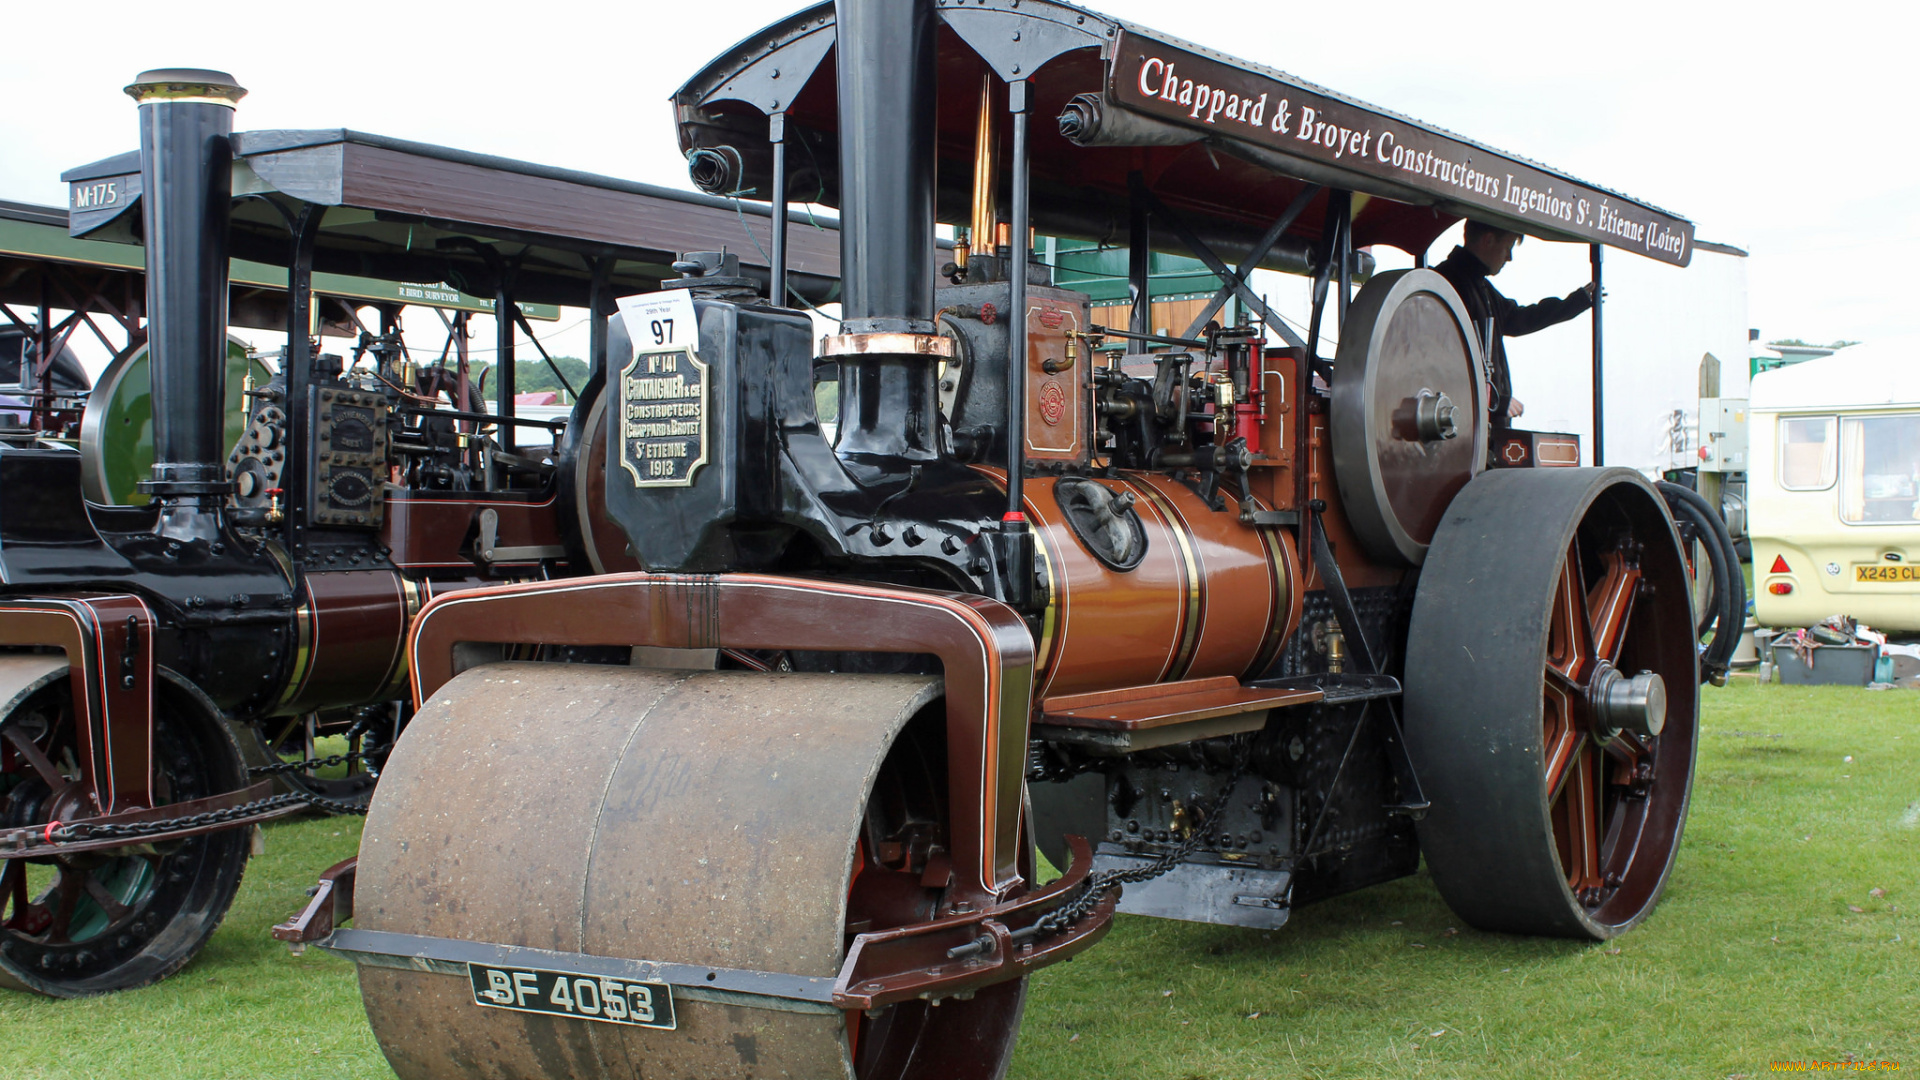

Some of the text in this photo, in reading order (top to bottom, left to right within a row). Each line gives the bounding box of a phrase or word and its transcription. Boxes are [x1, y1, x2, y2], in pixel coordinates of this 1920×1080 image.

[1138, 57, 1268, 127] Chappard
[1270, 99, 1293, 135] &
[1296, 105, 1372, 159] Broyet
[1376, 131, 1500, 198] Constructeurs
[1503, 174, 1573, 222] Ingeniors
[1597, 198, 1645, 243] Étienne
[1645, 222, 1686, 260] (Loire)
[76, 182, 117, 208] M-175
[425, 290, 460, 303] SURVEYOR
[651, 318, 674, 346] 97
[662, 355, 677, 373] 141
[626, 403, 701, 420] CONSTRUCTEURS
[646, 442, 687, 458] ETIENNE
[650, 461, 675, 476] 1913
[1859, 567, 1898, 580] X243
[486, 969, 655, 1023] BF 4053
